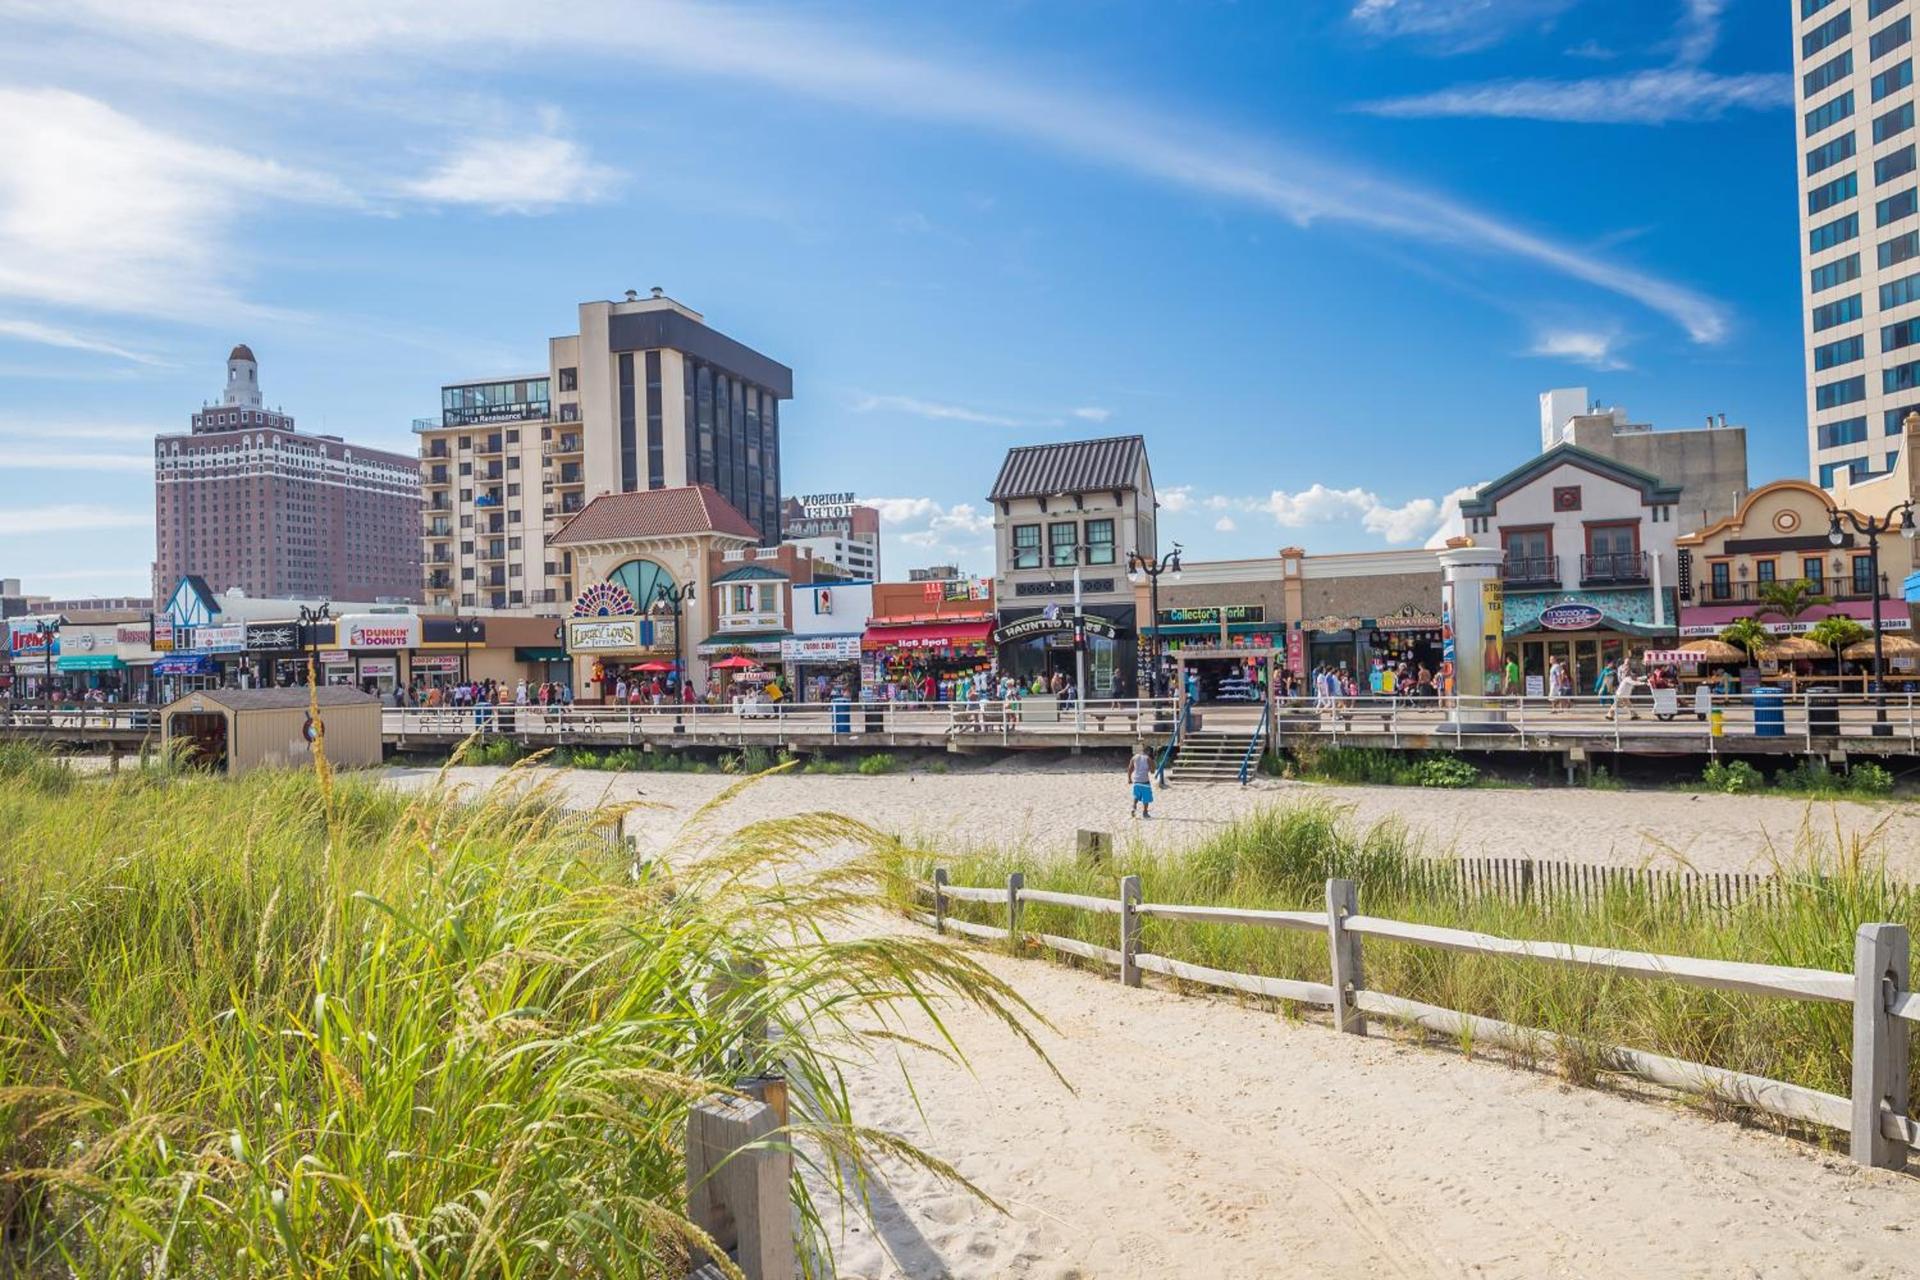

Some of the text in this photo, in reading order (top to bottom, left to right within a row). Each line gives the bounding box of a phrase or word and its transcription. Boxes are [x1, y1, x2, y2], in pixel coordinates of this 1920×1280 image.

[1171, 608, 1217, 621] Collector's
[365, 628, 409, 637] DUNKIN'
[1005, 620, 1062, 637] HAUNTED
[366, 637, 407, 646] DONUTS
[898, 638, 948, 648] Hot Spot
